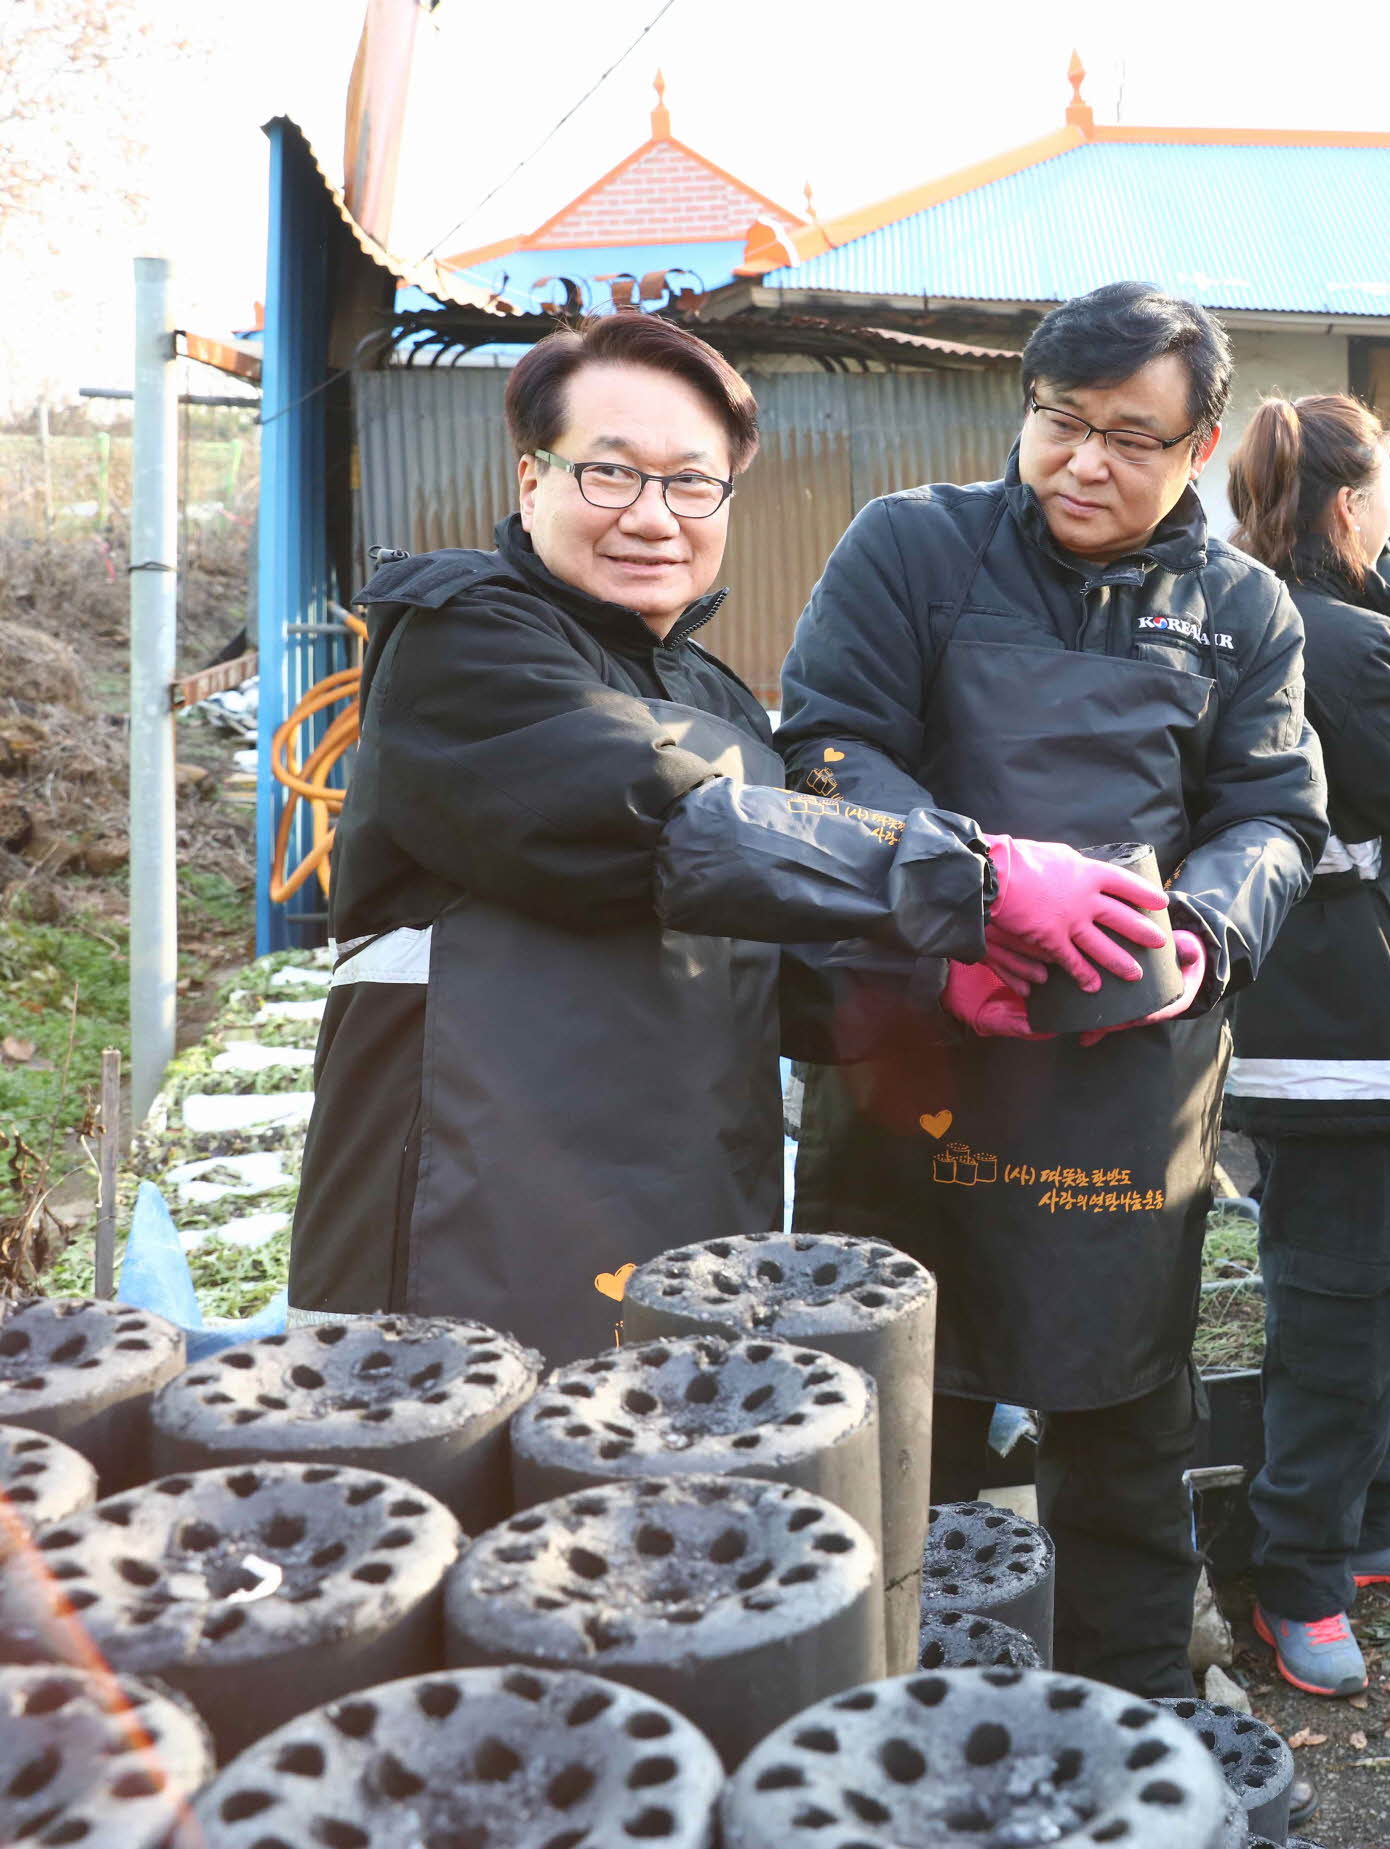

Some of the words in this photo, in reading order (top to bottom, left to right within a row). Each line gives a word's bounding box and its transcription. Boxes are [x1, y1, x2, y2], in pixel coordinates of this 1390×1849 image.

[1004, 1164, 1036, 1186] (사)
[1039, 1165, 1090, 1189] 따뜻한
[1091, 1167, 1133, 1187] 한반도
